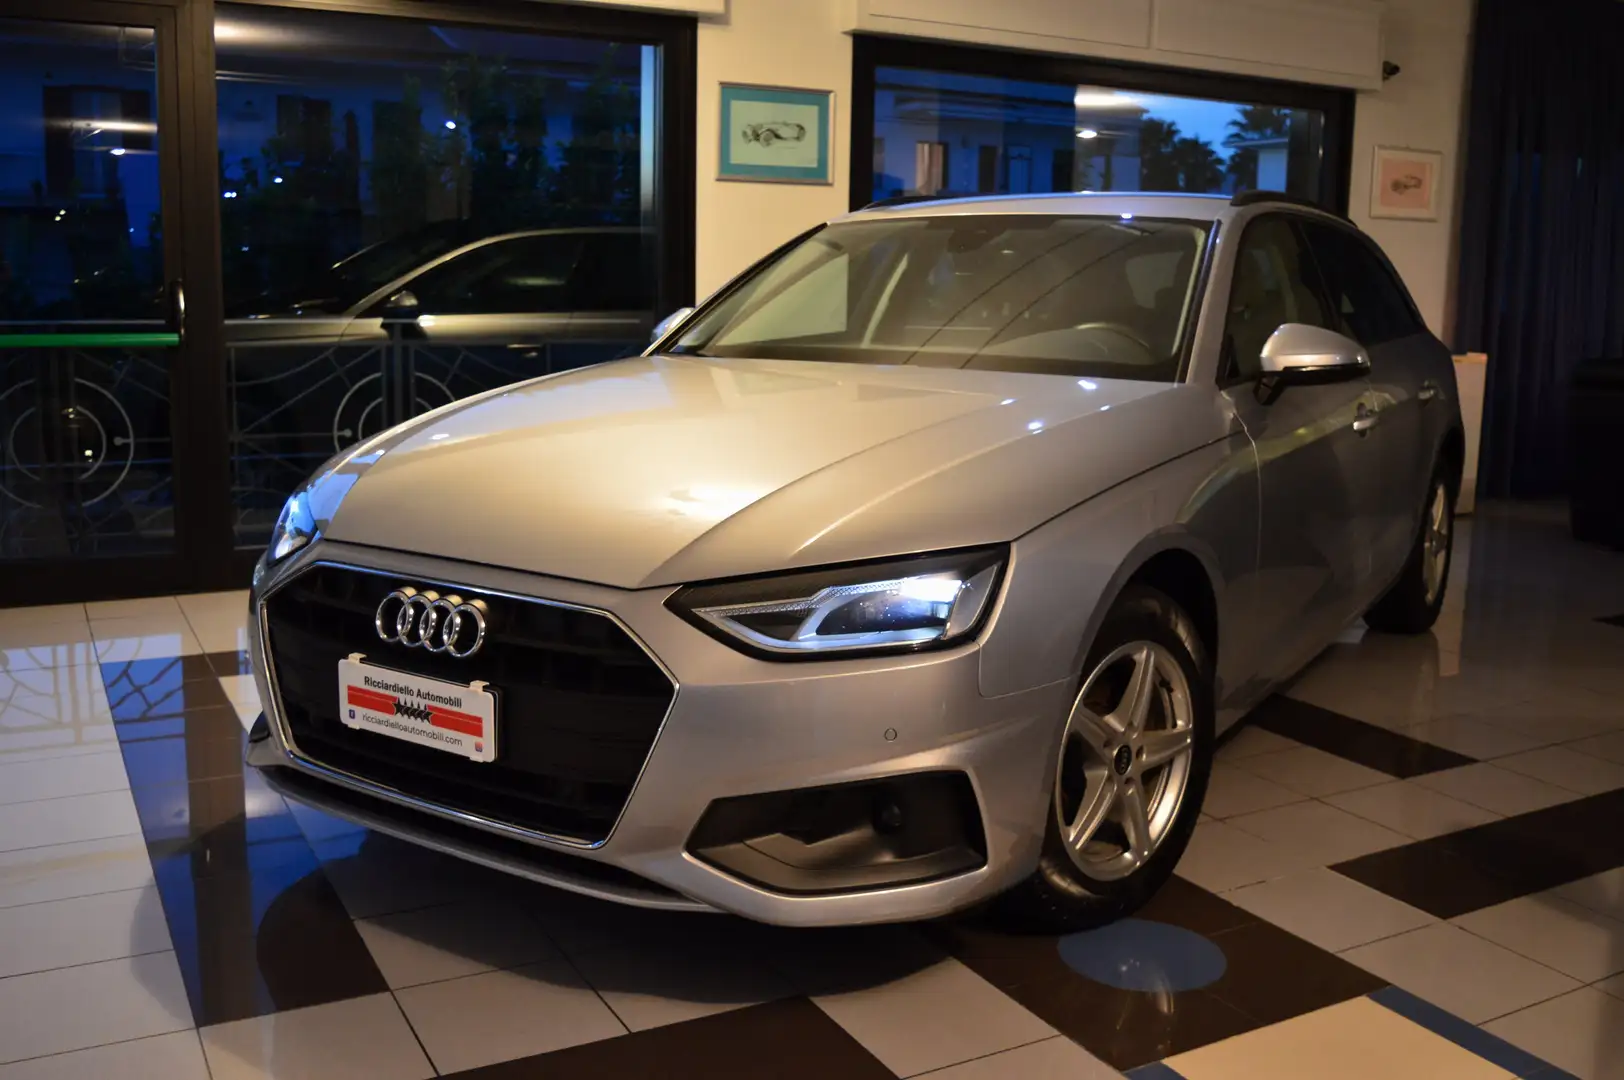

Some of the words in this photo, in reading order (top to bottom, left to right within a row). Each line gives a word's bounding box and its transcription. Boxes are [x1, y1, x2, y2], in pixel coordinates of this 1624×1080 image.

[364, 676, 414, 697] Ricciardiello
[416, 688, 462, 709] Automobili
[362, 712, 463, 746] ricciardielloautomobili.com
